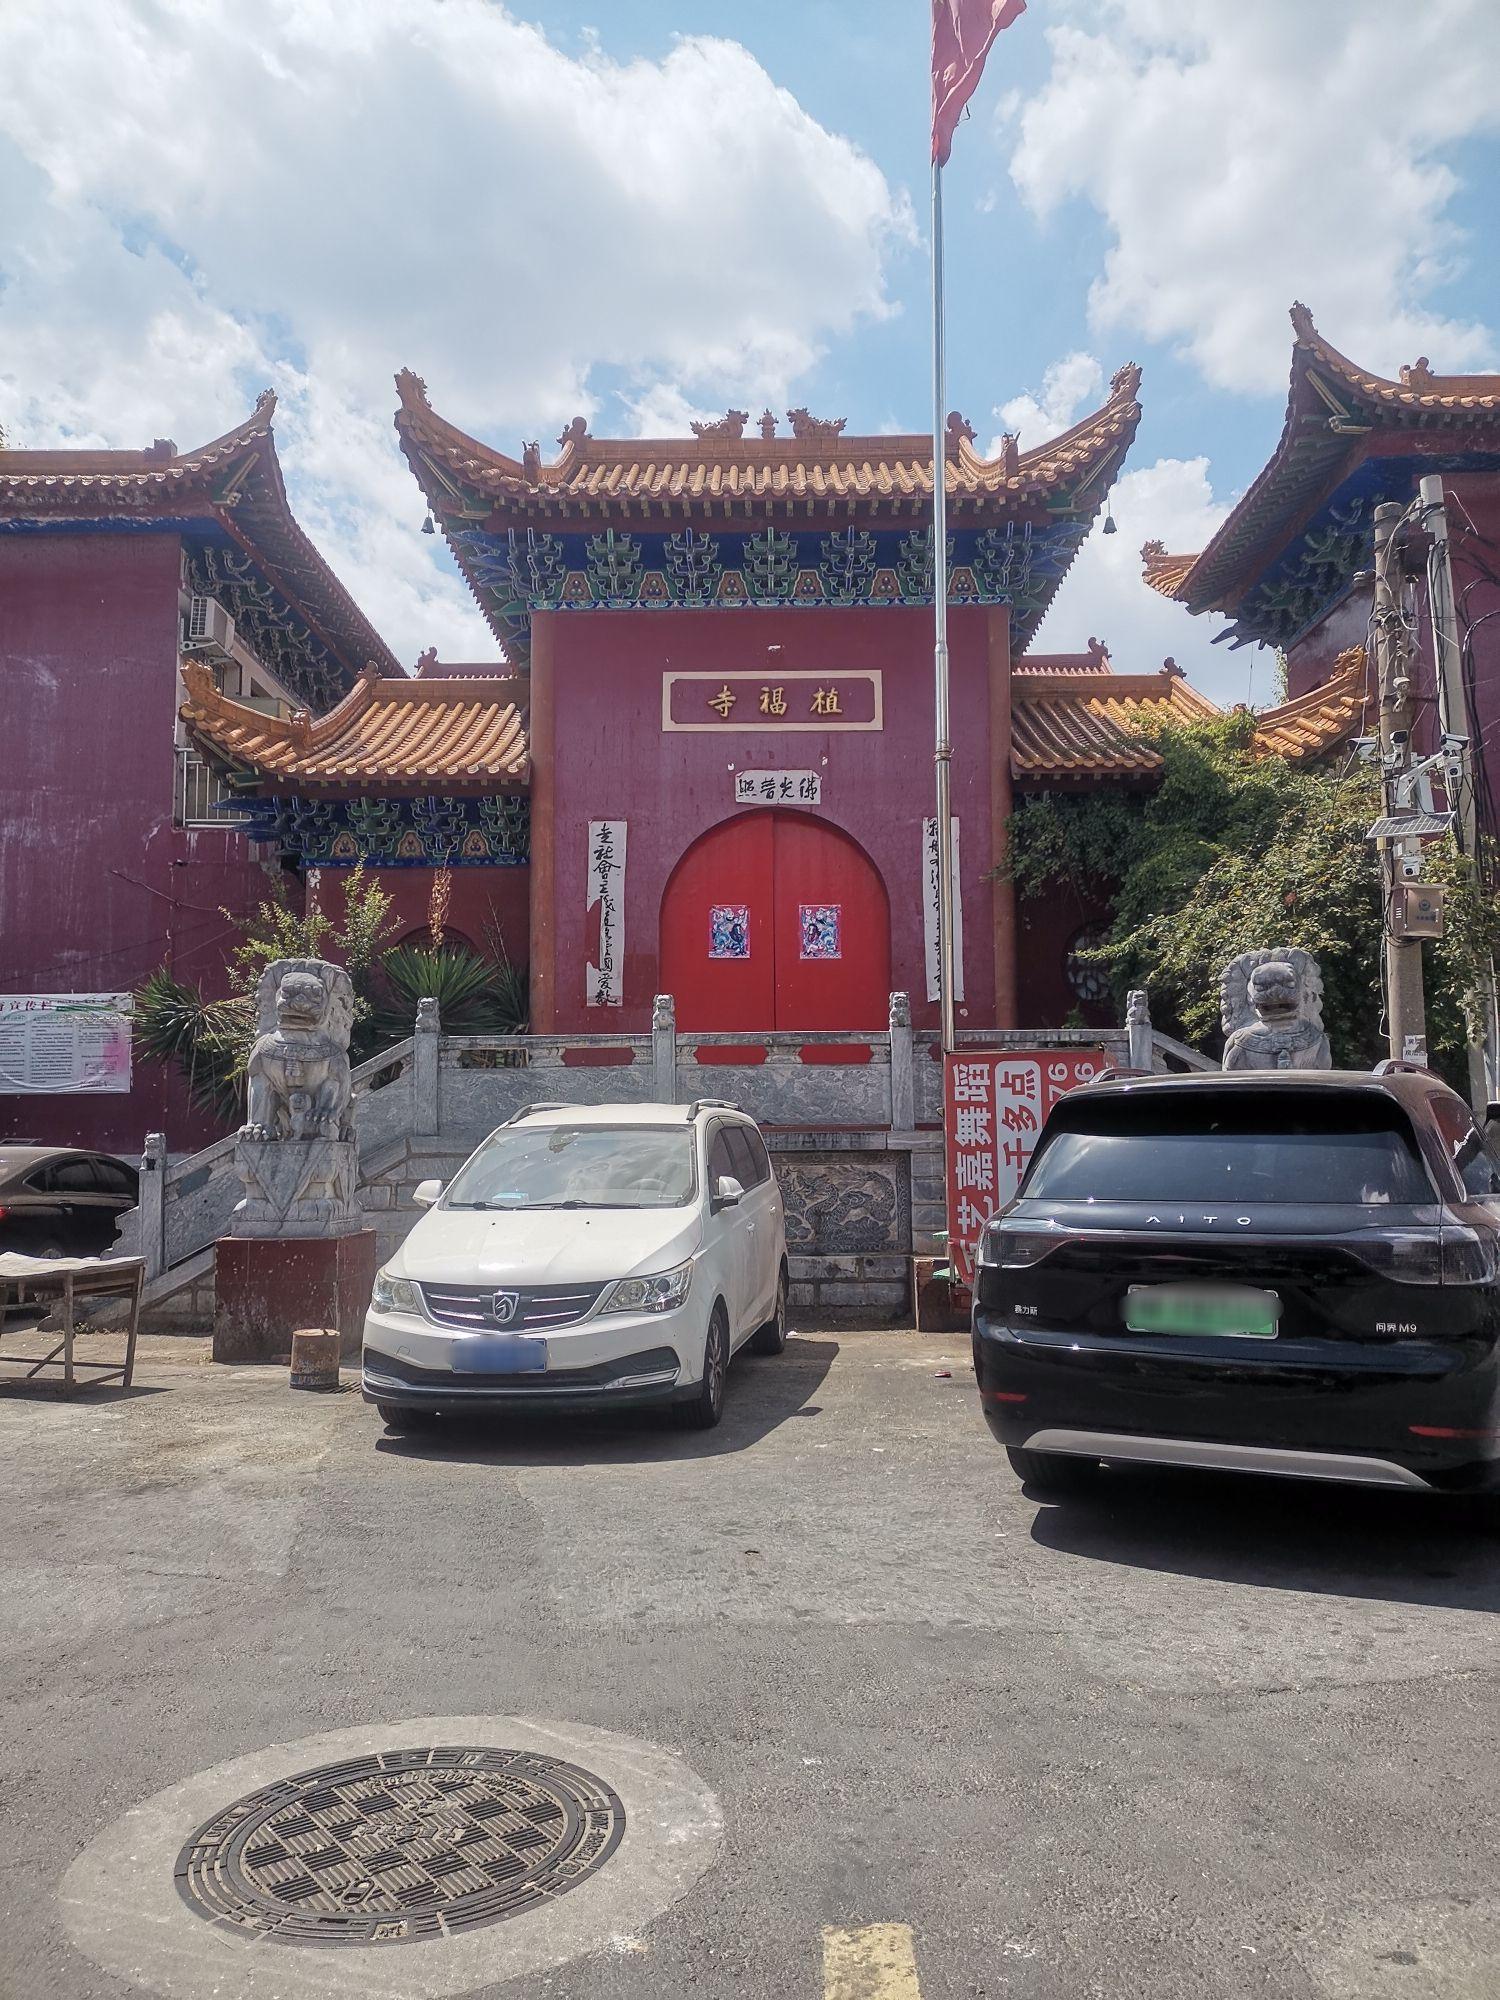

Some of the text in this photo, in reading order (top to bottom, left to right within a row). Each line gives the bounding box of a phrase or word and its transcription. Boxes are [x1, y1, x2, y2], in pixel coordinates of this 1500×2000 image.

[707, 685, 843, 717] 植福寺
[0, 1000, 53, 1011] 宣传栏
[1146, 1214, 1251, 1226] AITO
[1399, 1323, 1417, 1333] M9
